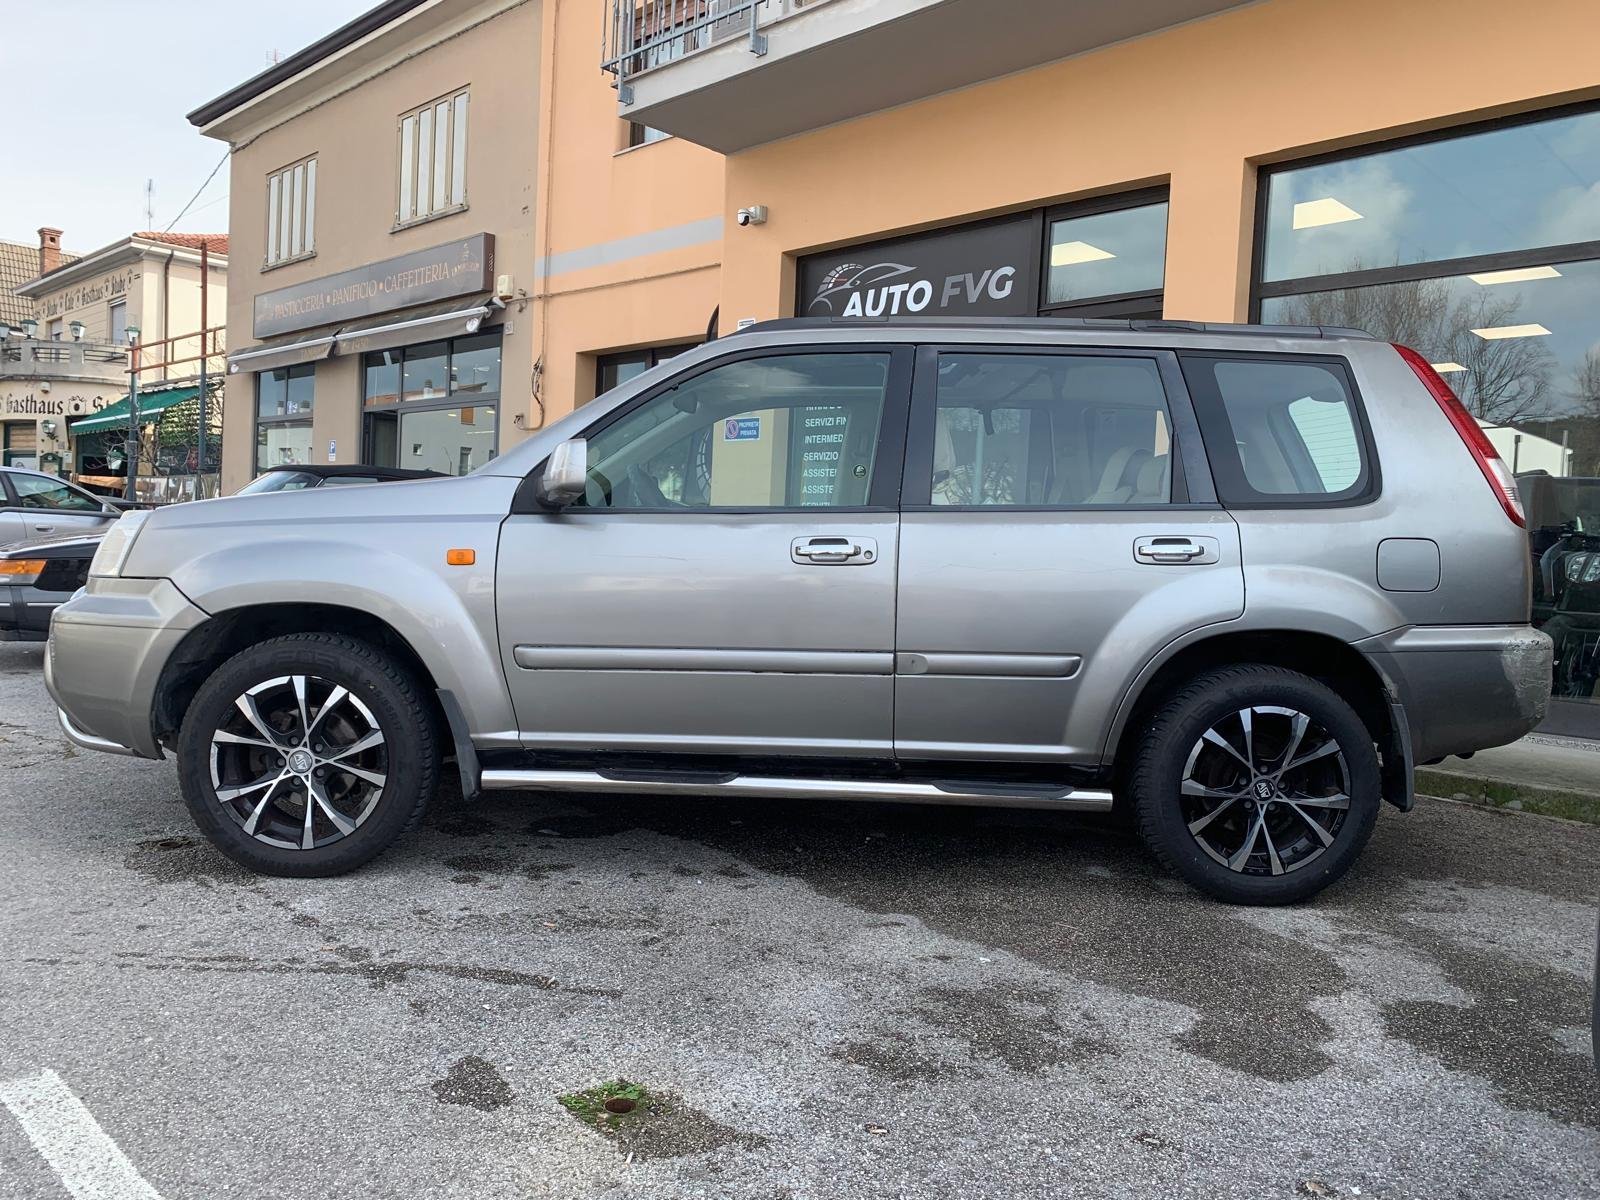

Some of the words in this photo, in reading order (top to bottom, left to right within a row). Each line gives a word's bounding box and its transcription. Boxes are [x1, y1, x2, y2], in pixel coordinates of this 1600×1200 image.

[274, 292, 325, 319] PASTICCERIA
[331, 279, 378, 306] PANIFICIO
[384, 261, 450, 293] CAFFETTERIA
[842, 280, 933, 317] AUTO
[940, 266, 1016, 308] FVG
[6, 393, 64, 415] Gasthaus
[804, 417, 835, 428] SERVIZI
[804, 433, 844, 444] INTERMED
[803, 451, 839, 461] SERVIZIO
